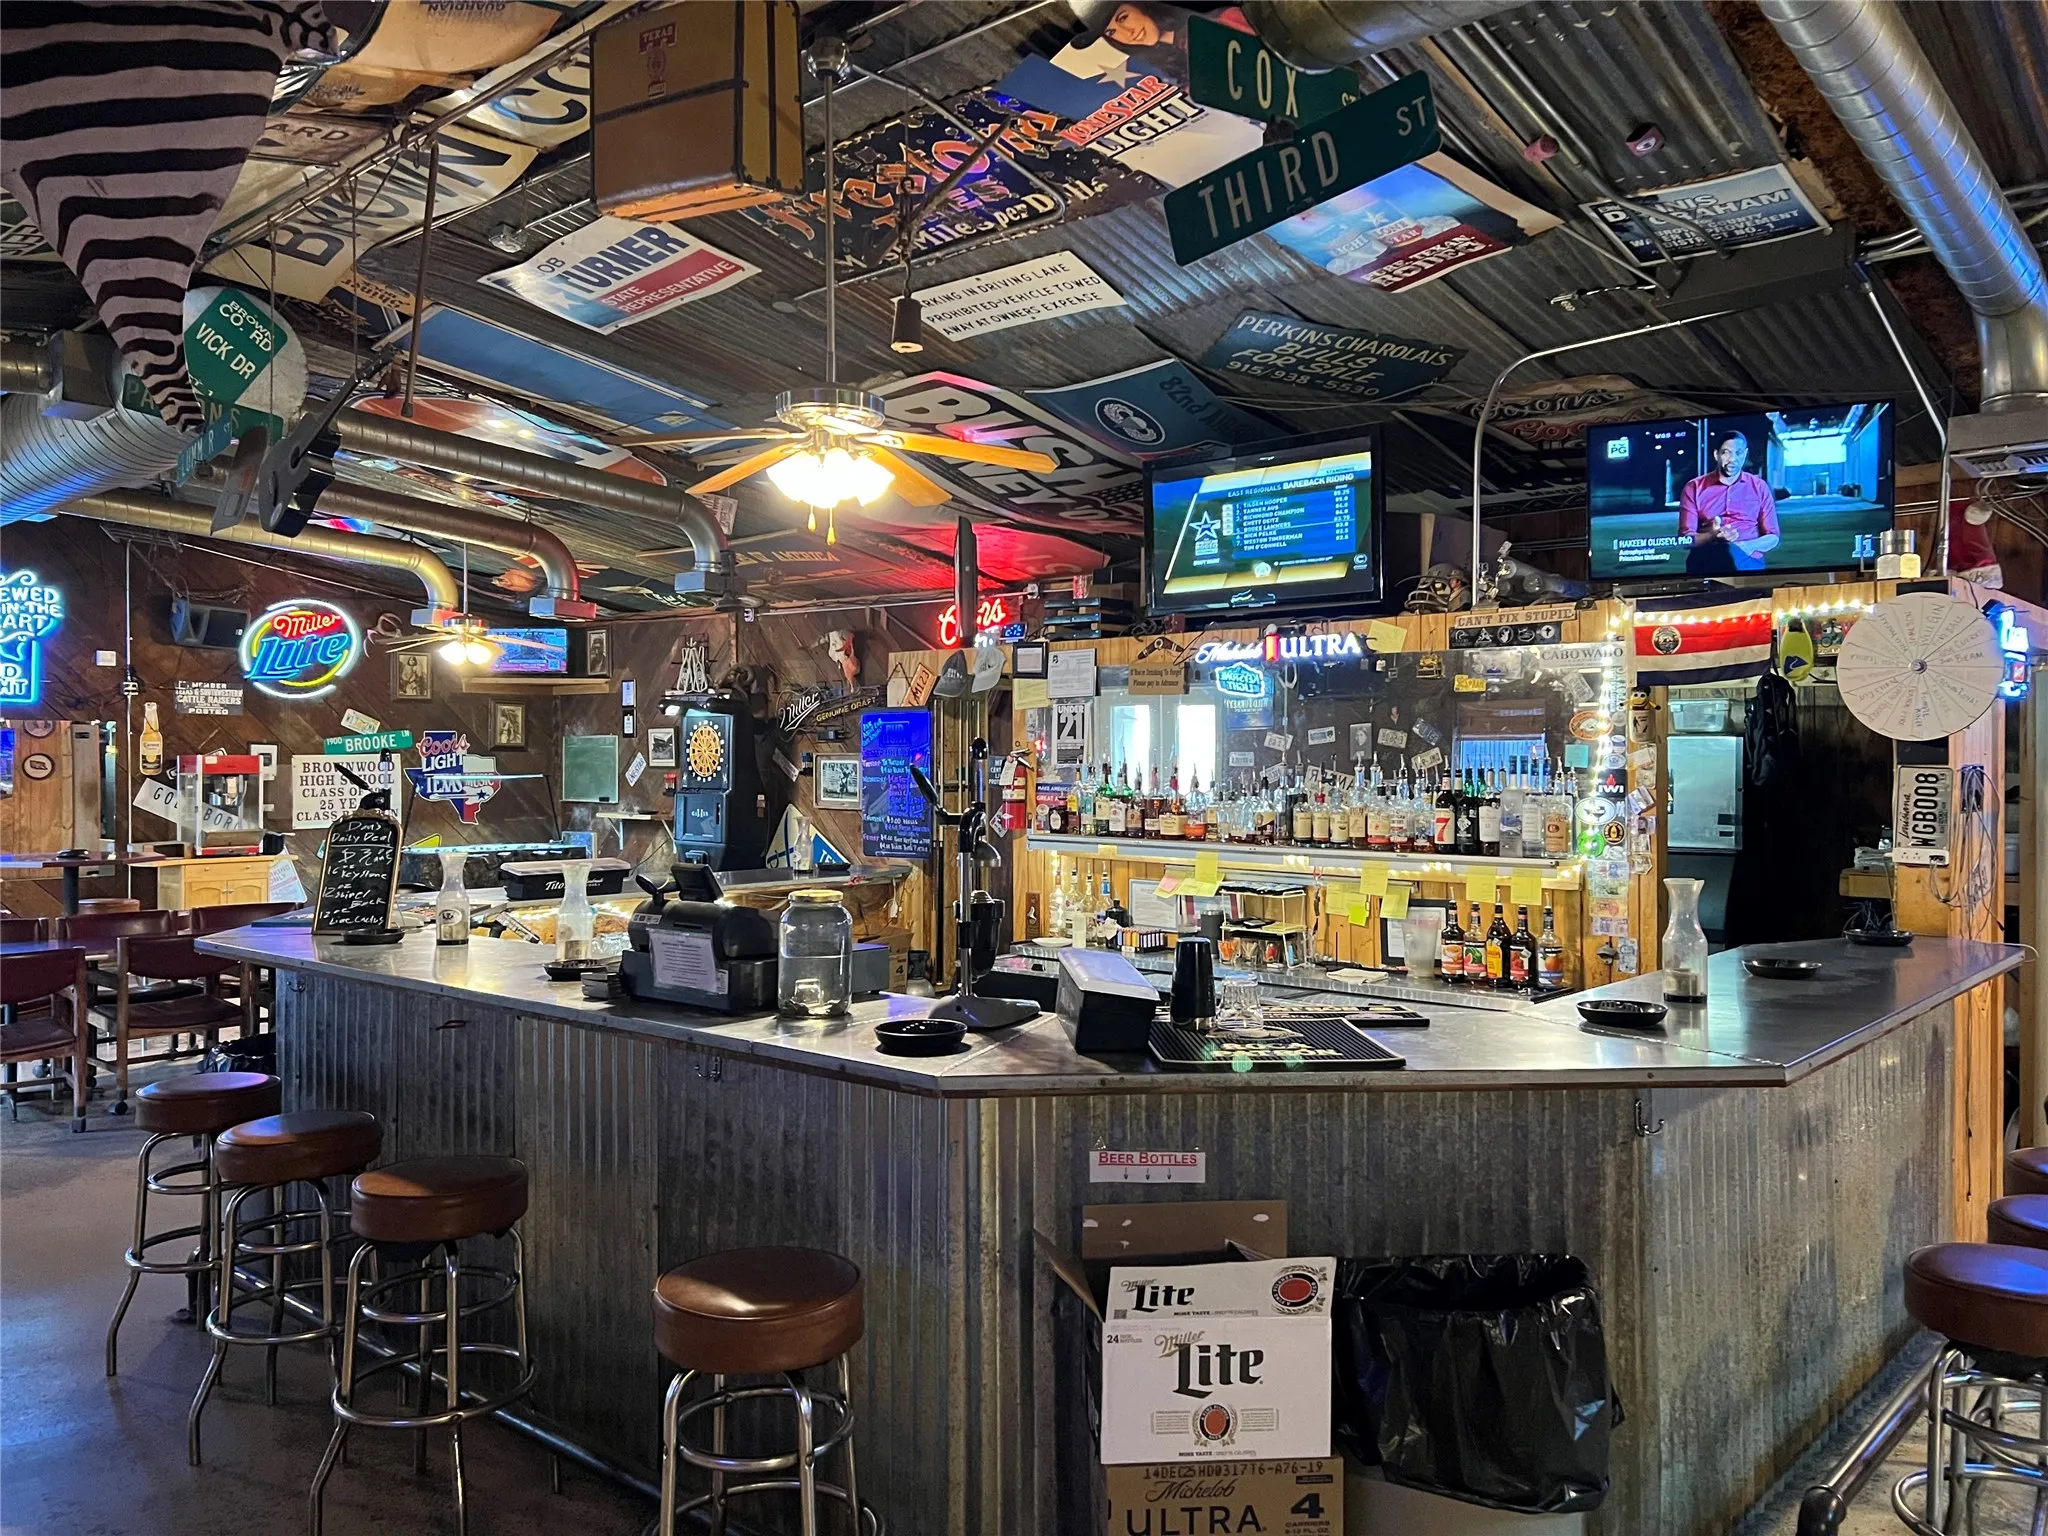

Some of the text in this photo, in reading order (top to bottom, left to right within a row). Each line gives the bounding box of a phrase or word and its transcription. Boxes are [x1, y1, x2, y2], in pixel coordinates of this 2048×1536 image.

[1227, 40, 1299, 118] COX
[1086, 92, 1201, 157] LIGHT
[1199, 96, 1429, 240] THIRD ST
[1663, 232, 1728, 248] DISTRCT
[554, 226, 690, 294] TURNER
[619, 260, 736, 313] REPRESENTATIVE
[963, 287, 976, 301] IN
[977, 273, 1032, 293] DRIVING
[1033, 263, 1070, 281] LANE
[1054, 275, 1101, 293] TOWED
[602, 286, 645, 307] STATE
[229, 299, 276, 339] BROWN
[943, 292, 1102, 336] AWAY AT OWNERS EXPENSE
[219, 303, 273, 353] CO. RD
[195, 322, 257, 381] VICK DR
[1238, 315, 1454, 367] PERKINS CHAROLAIS
[1232, 349, 1385, 384] FOR SALE
[1273, 342, 1377, 369] BULLS
[1159, 376, 1212, 415] 82nd
[1610, 446, 1627, 454] PG
[1283, 478, 1325, 490] BAREBACK
[1326, 473, 1354, 484] RIDING
[1619, 539, 1647, 548] HAKEEM
[273, 613, 342, 638] Miller
[1457, 614, 1494, 628] CAN'T
[1497, 612, 1519, 623] FIX
[1926, 602, 1946, 626] GIN
[243, 634, 350, 680] Lite
[1280, 632, 1361, 657] ULTRA
[1541, 649, 1579, 661] CABO
[1957, 651, 1985, 664] BEAM
[177, 695, 242, 705] CATTLE RAISERS
[188, 708, 229, 716] POSTED
[779, 692, 819, 730] Miller
[816, 697, 877, 722] GENUINE DRAFT
[1058, 705, 1085, 714] UNDER
[1060, 713, 1084, 740] 21
[326, 737, 343, 746] 1900
[345, 734, 398, 752] BROOKE
[419, 734, 468, 757] Coors
[422, 753, 464, 772] LIGHT
[300, 775, 335, 786] HIGH
[302, 788, 345, 798] CLASS
[1598, 785, 1624, 794] IWI
[296, 811, 338, 822] CLASS
[320, 800, 334, 810] 25
[1898, 792, 1911, 839] Louisiana
[331, 831, 392, 843] Daily Deal
[1435, 817, 1451, 842] 7
[1121, 1277, 1157, 1293] Miller
[1132, 1284, 1195, 1313] Lite
[1107, 1334, 1119, 1344] 24
[1154, 1330, 1206, 1358] Miller
[1173, 1343, 1264, 1399] Lite
[1145, 1478, 1239, 1503] Michelob
[1127, 1492, 1325, 1536] ULTRA 4
